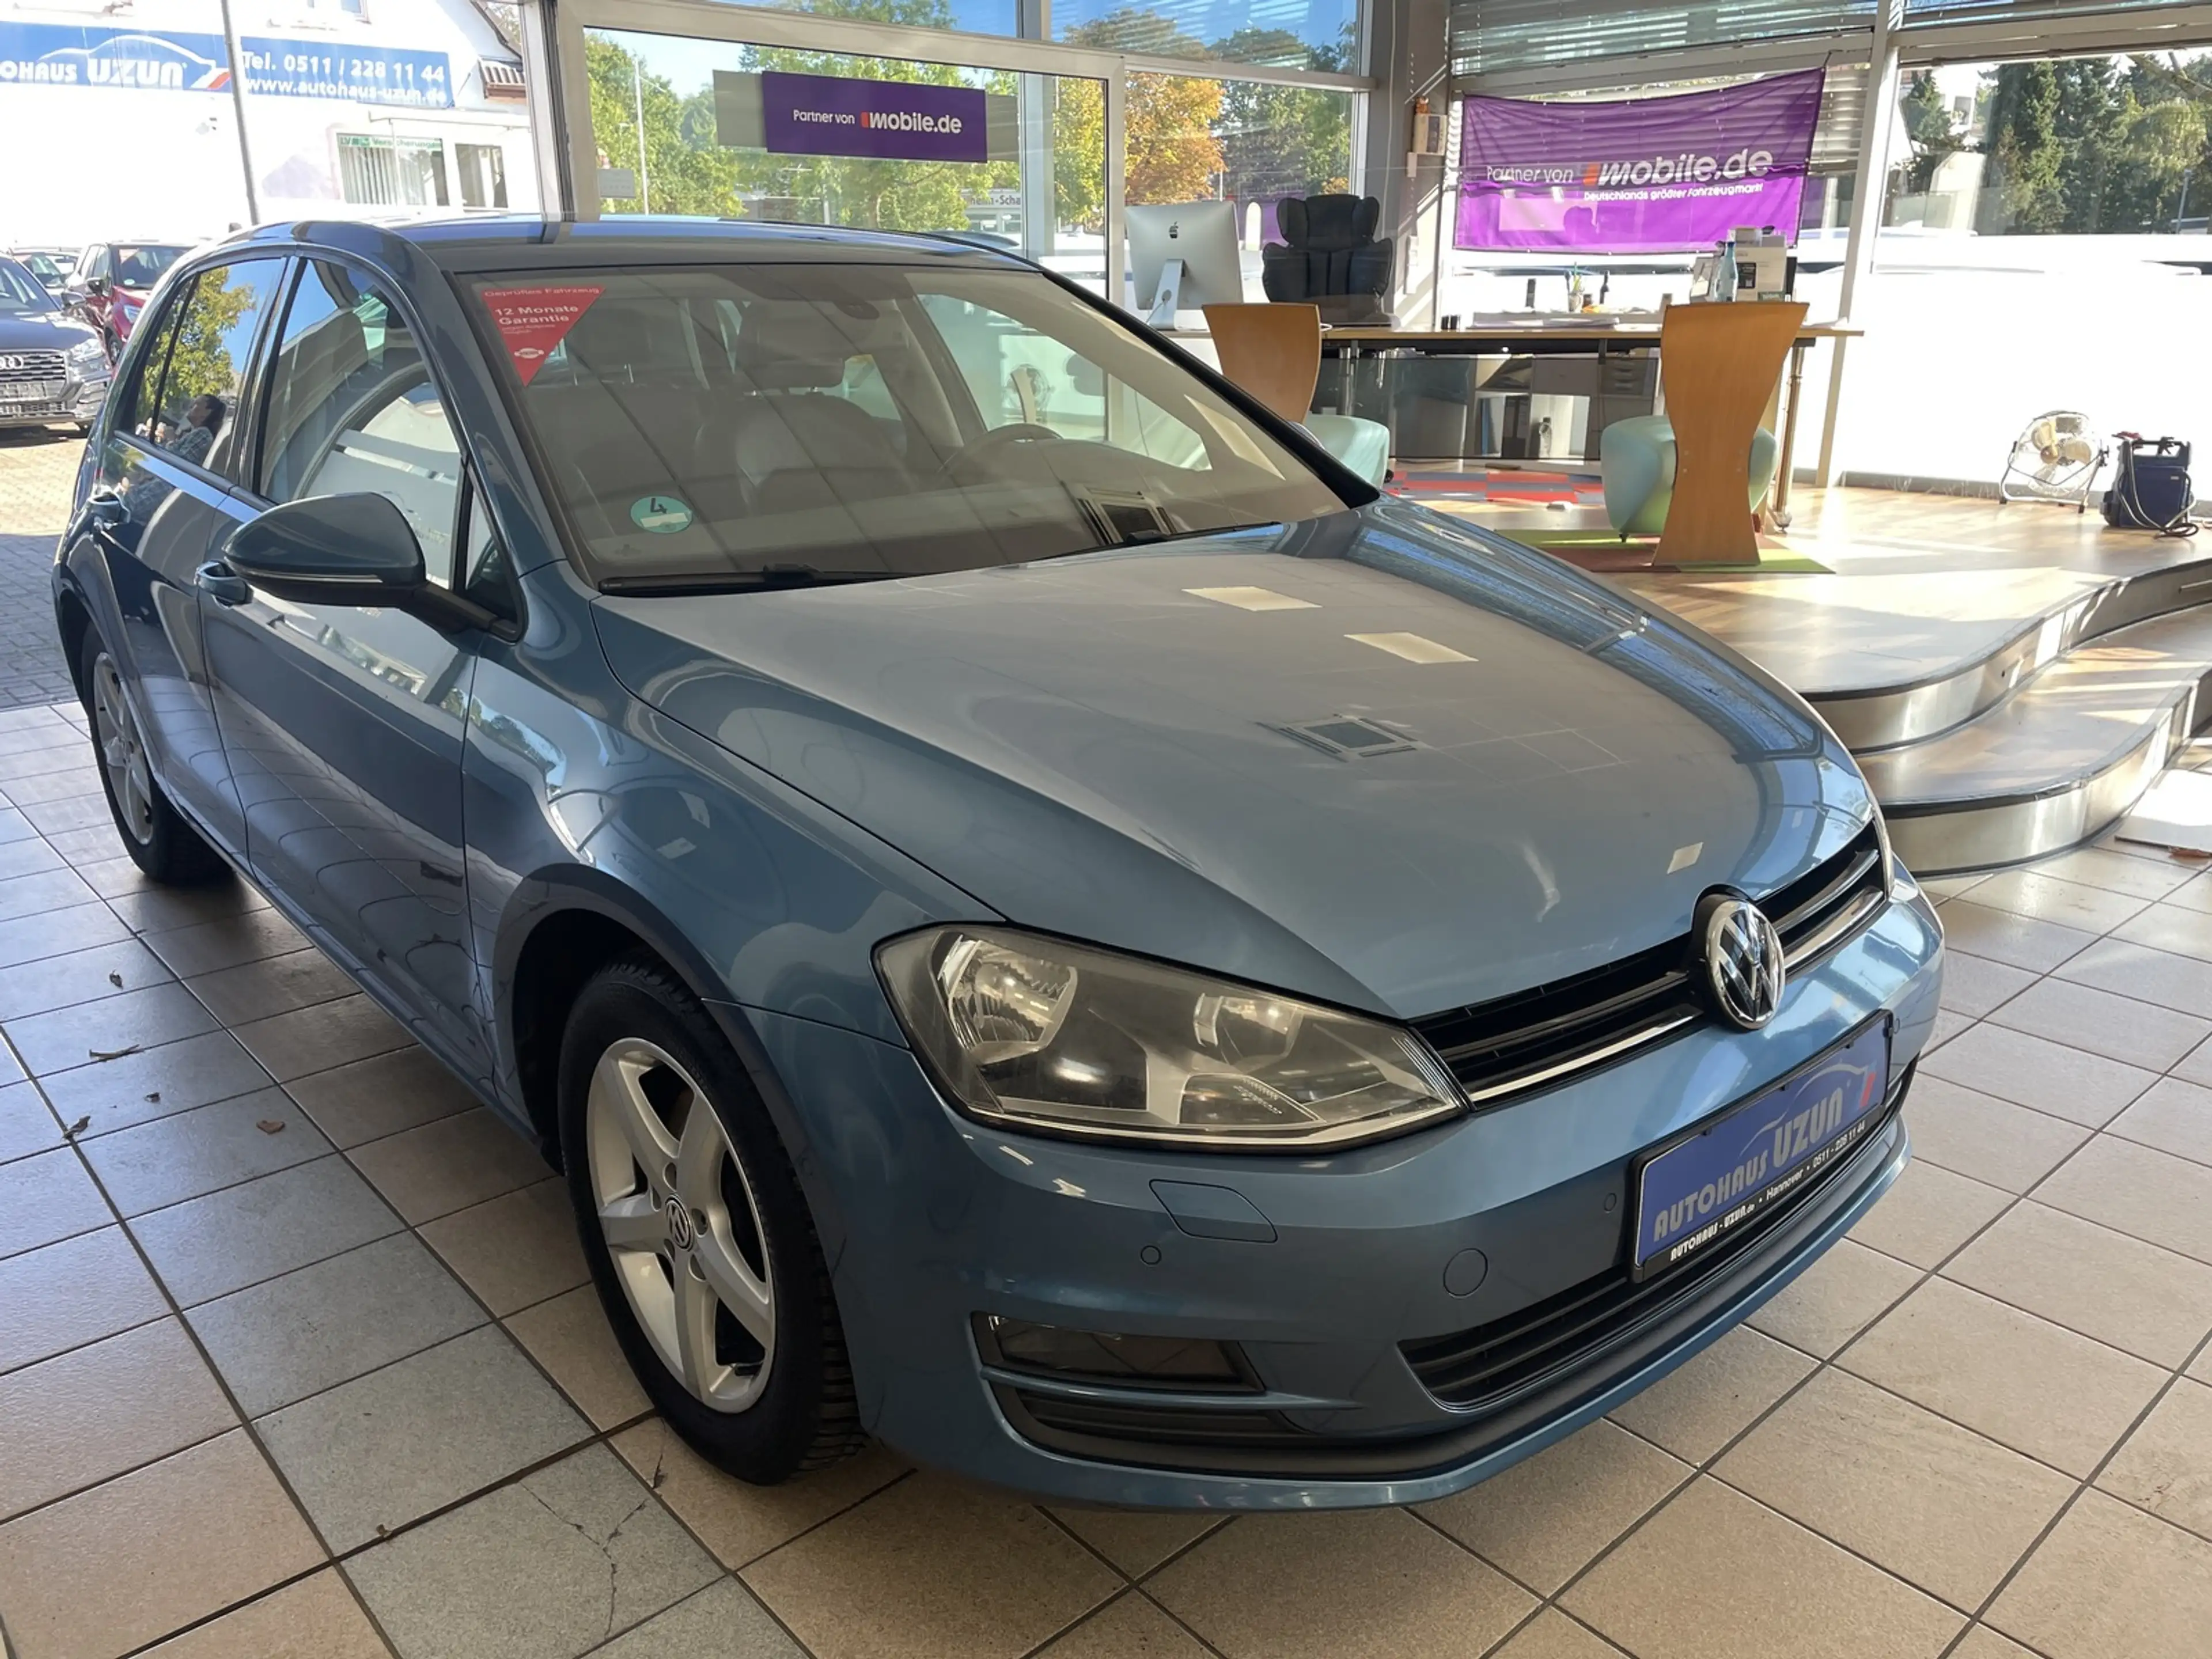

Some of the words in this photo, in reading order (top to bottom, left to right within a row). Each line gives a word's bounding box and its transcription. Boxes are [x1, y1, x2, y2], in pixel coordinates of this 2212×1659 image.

[88, 58, 183, 90] UZUN
[242, 51, 276, 70] Tel.
[284, 54, 331, 74] 0511
[351, 59, 386, 78] 228
[393, 62, 414, 81] 11
[421, 65, 445, 82] 44
[247, 78, 447, 105] www.autohaus-uzun.de
[793, 109, 833, 123] Partner
[835, 113, 855, 124] von
[869, 112, 962, 134] mobile.de
[1486, 165, 1540, 182] Partner
[1543, 168, 1574, 183] von
[1597, 148, 1774, 186] mobile.de
[1585, 189, 1648, 202] Deutschlands
[495, 308, 514, 316] 12
[519, 305, 579, 315] Monate
[499, 315, 569, 325] Garantie
[1654, 1150, 1768, 1243] AUTOHAUS
[1772, 1088, 1842, 1168] UZUN
[1766, 1168, 1804, 1200] Hannover
[1813, 1147, 1830, 1168] 0511
[1835, 1134, 1848, 1151] 228
[1849, 1127, 1857, 1141] 11
